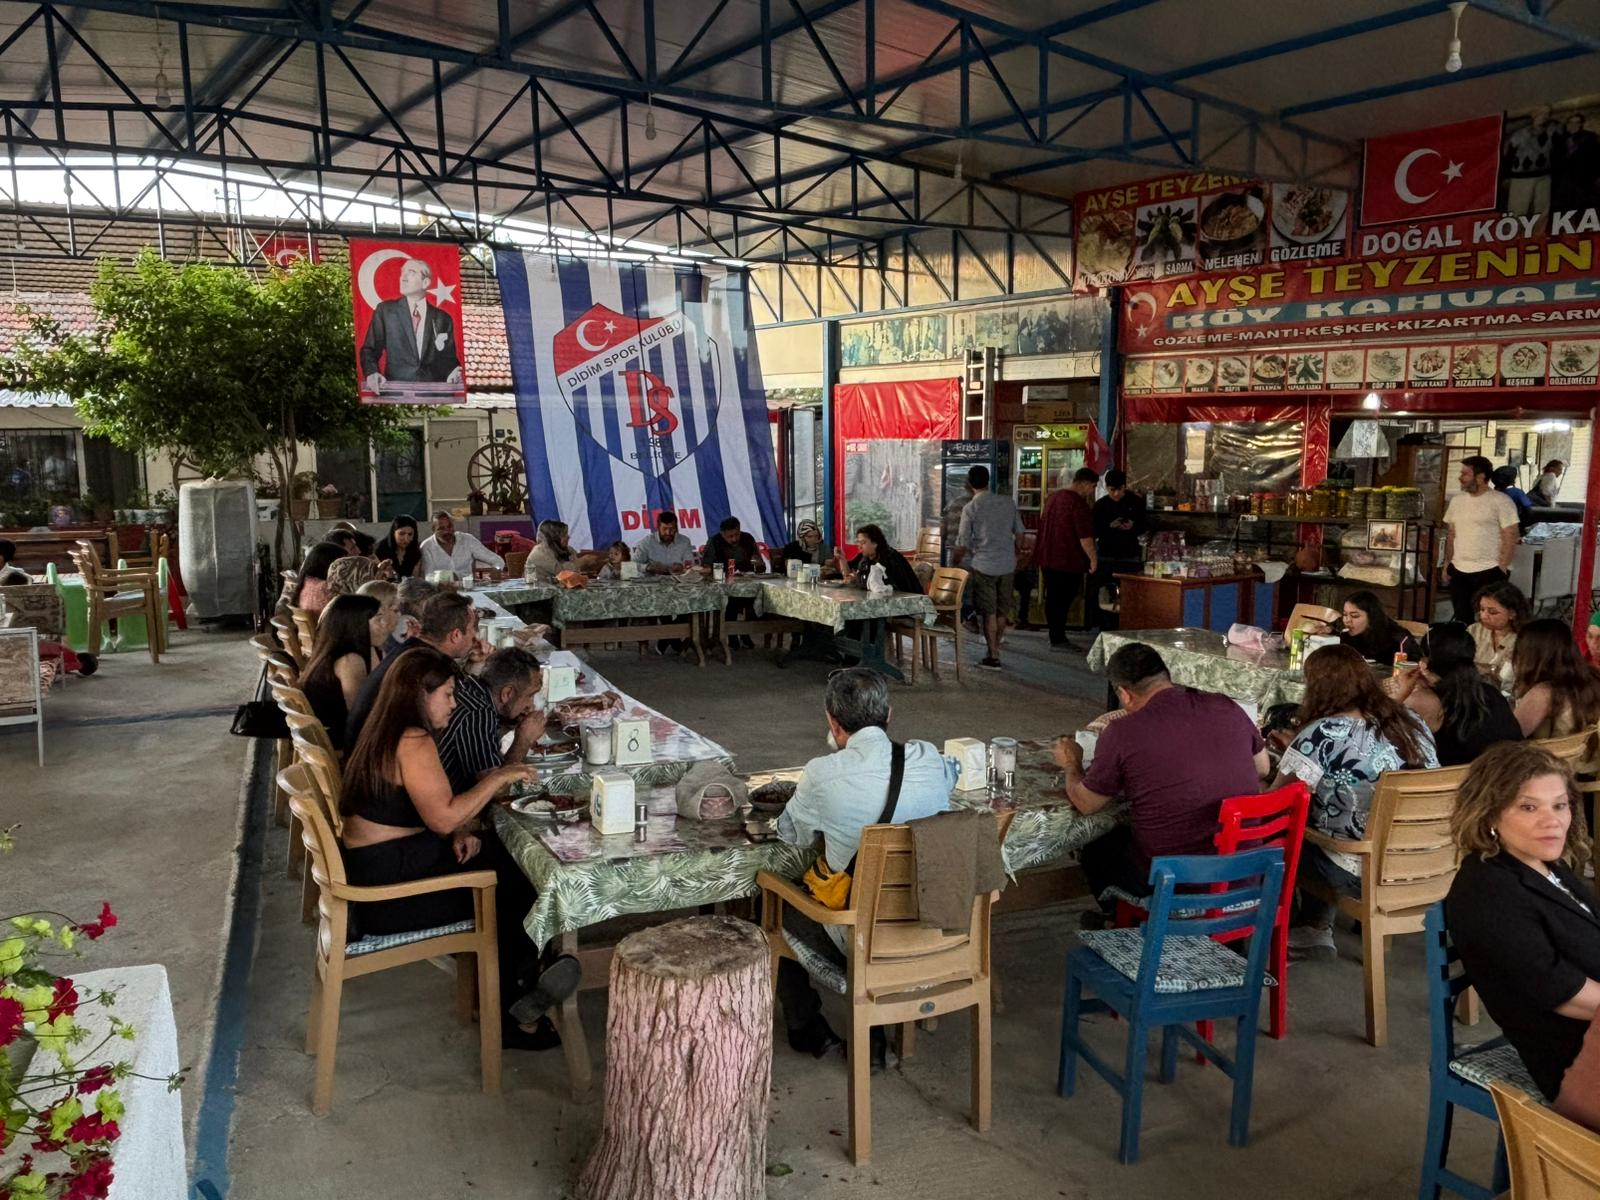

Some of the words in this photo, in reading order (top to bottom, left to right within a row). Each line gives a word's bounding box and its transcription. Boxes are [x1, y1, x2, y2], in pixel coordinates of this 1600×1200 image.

[1270, 242, 1342, 262] GÖZLEME
[1362, 225, 1462, 256] DOĞAL
[1473, 213, 1541, 244] KÖY
[1167, 271, 1285, 307] AYŞE
[1172, 307, 1283, 329] KÖY
[1305, 281, 1600, 319] KAHVAL
[567, 364, 602, 388] DİDİM
[603, 344, 638, 368] SPOR
